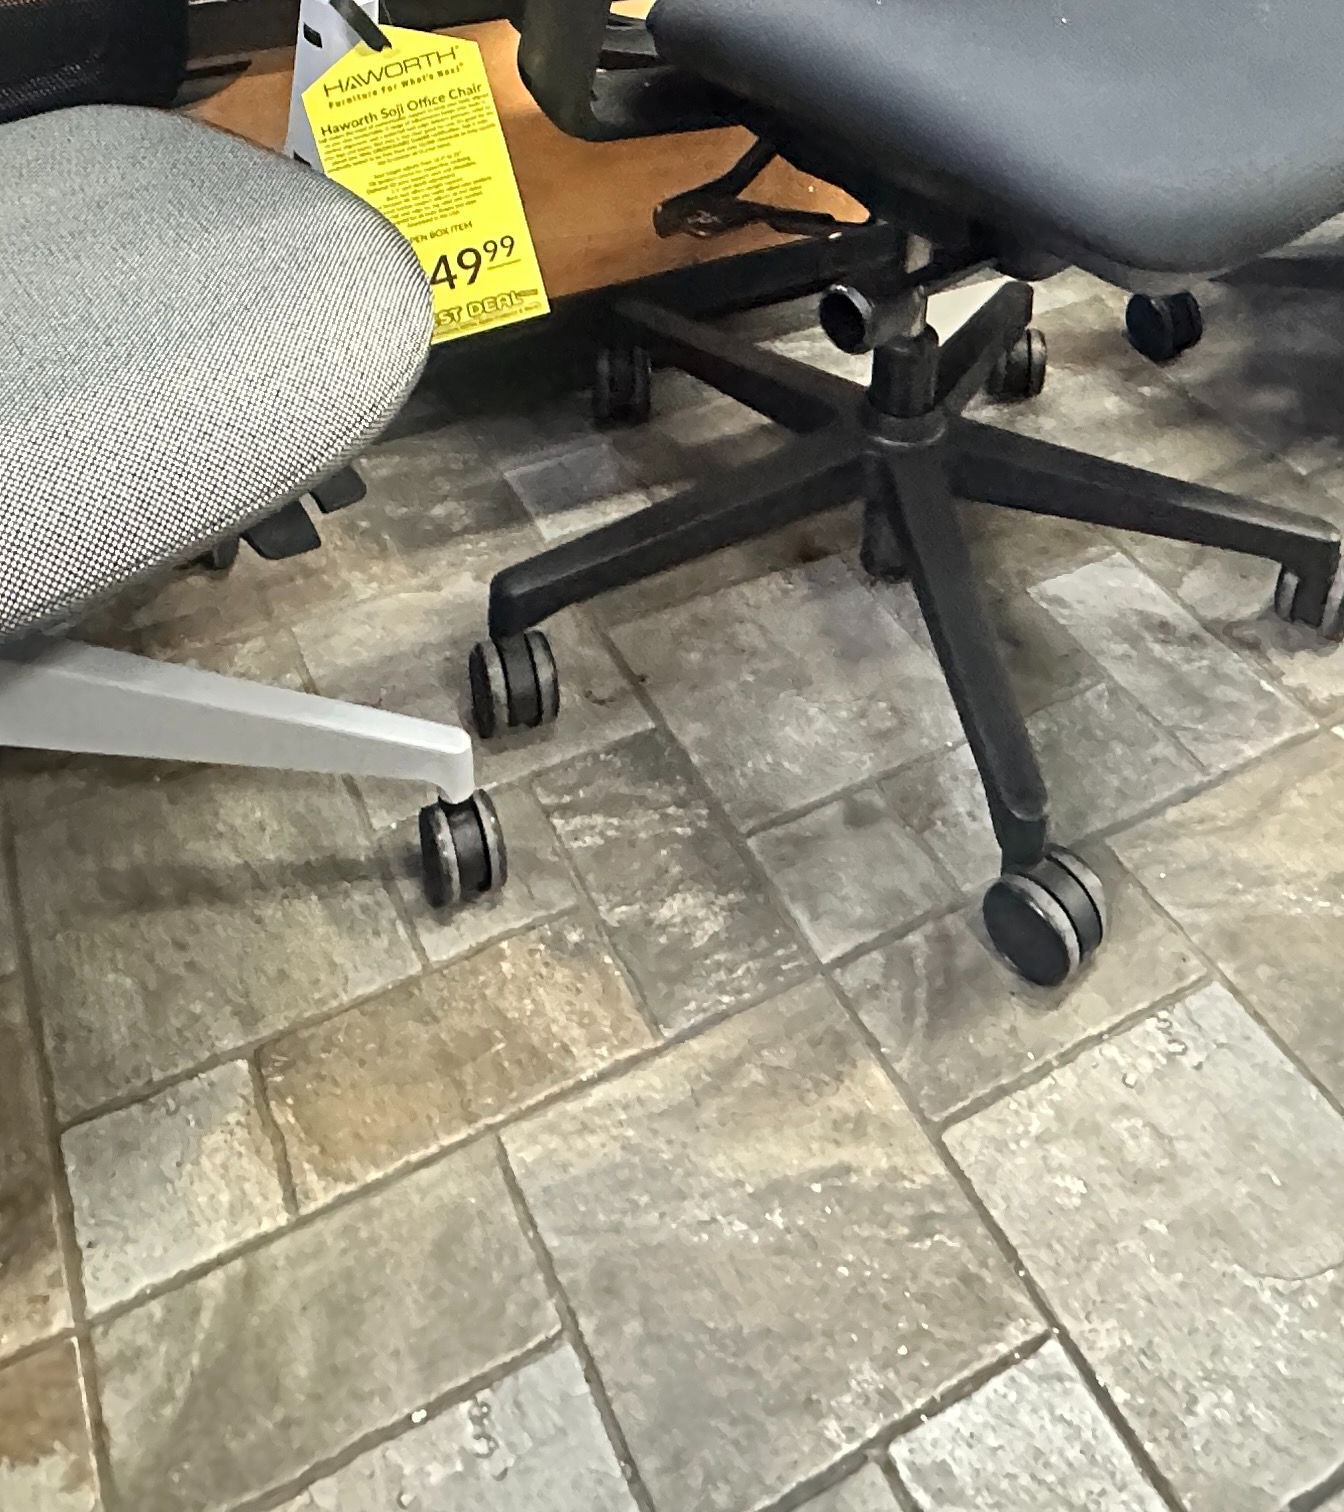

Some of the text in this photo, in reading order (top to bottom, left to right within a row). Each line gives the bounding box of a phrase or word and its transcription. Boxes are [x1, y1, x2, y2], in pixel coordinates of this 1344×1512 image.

[323, 47, 457, 97] HAWORTH
[321, 112, 378, 136] Haworth
[407, 93, 446, 112] Office
[449, 83, 482, 99] Chair
[410, 234, 428, 243] PEN
[430, 248, 482, 289] 49
[436, 290, 523, 326] ST DEAL
